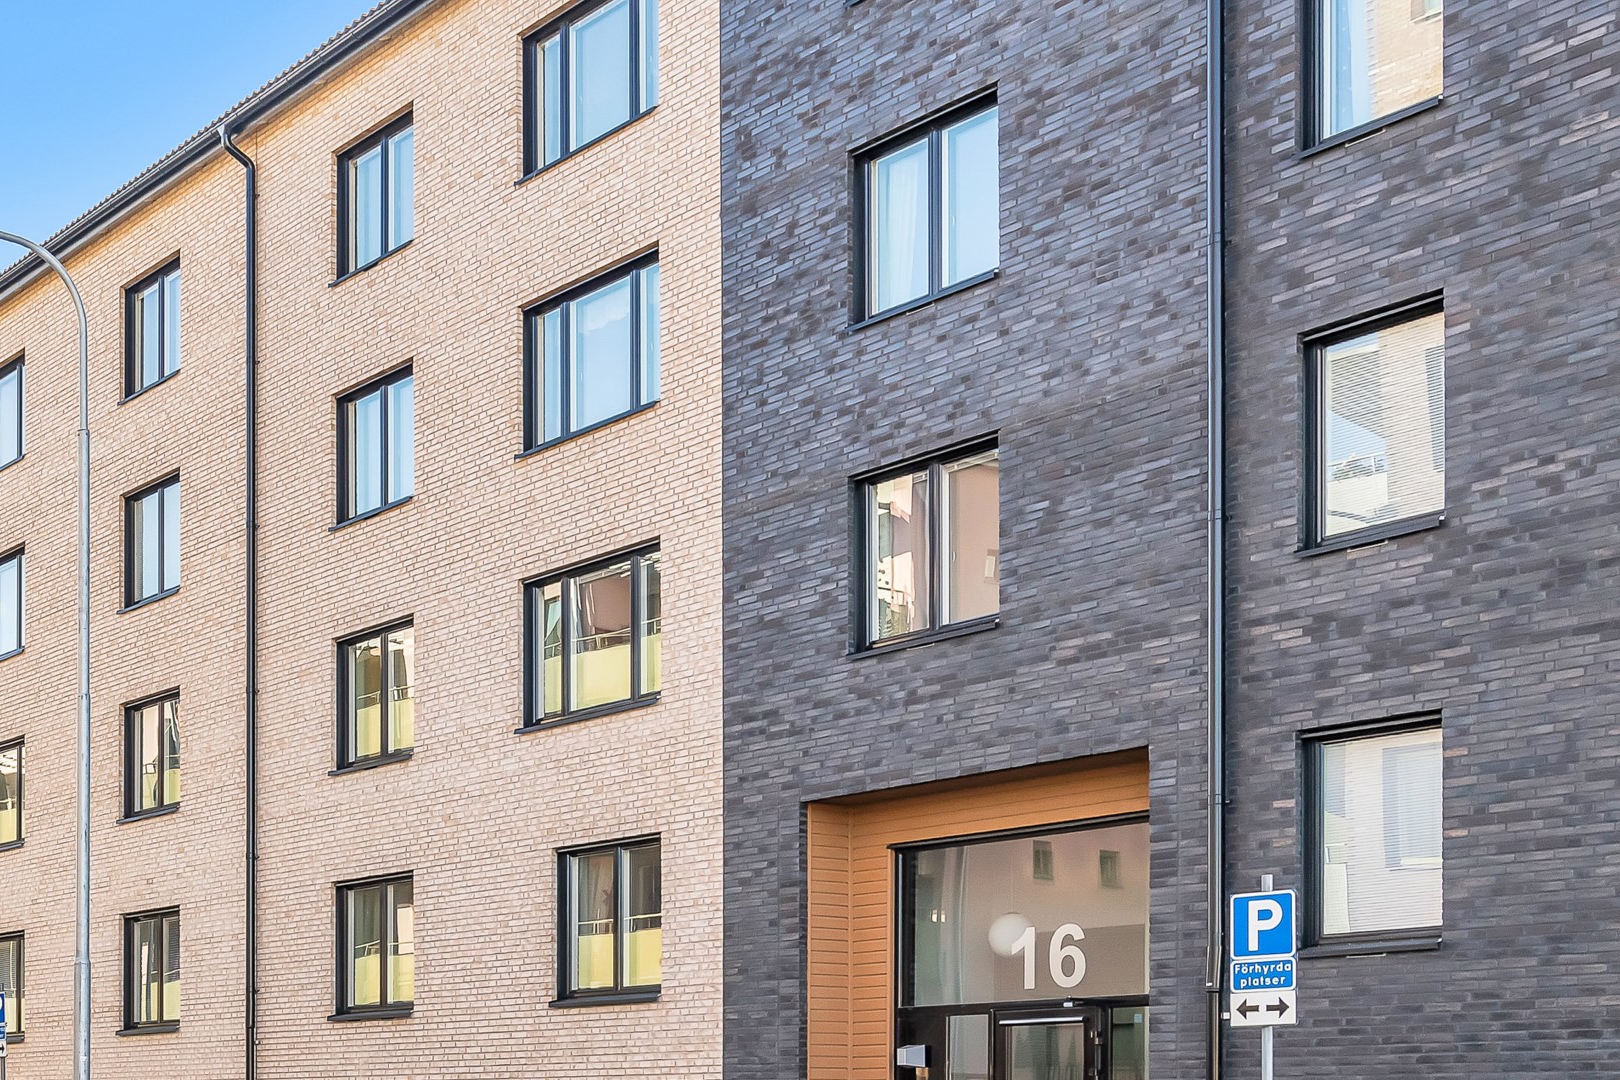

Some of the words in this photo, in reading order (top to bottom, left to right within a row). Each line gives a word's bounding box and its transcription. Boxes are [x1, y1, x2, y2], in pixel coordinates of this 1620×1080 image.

[1248, 899, 1283, 951] P
[1011, 923, 1087, 990] 16
[1234, 961, 1292, 976] Förhyrda
[1240, 975, 1286, 989] platser
